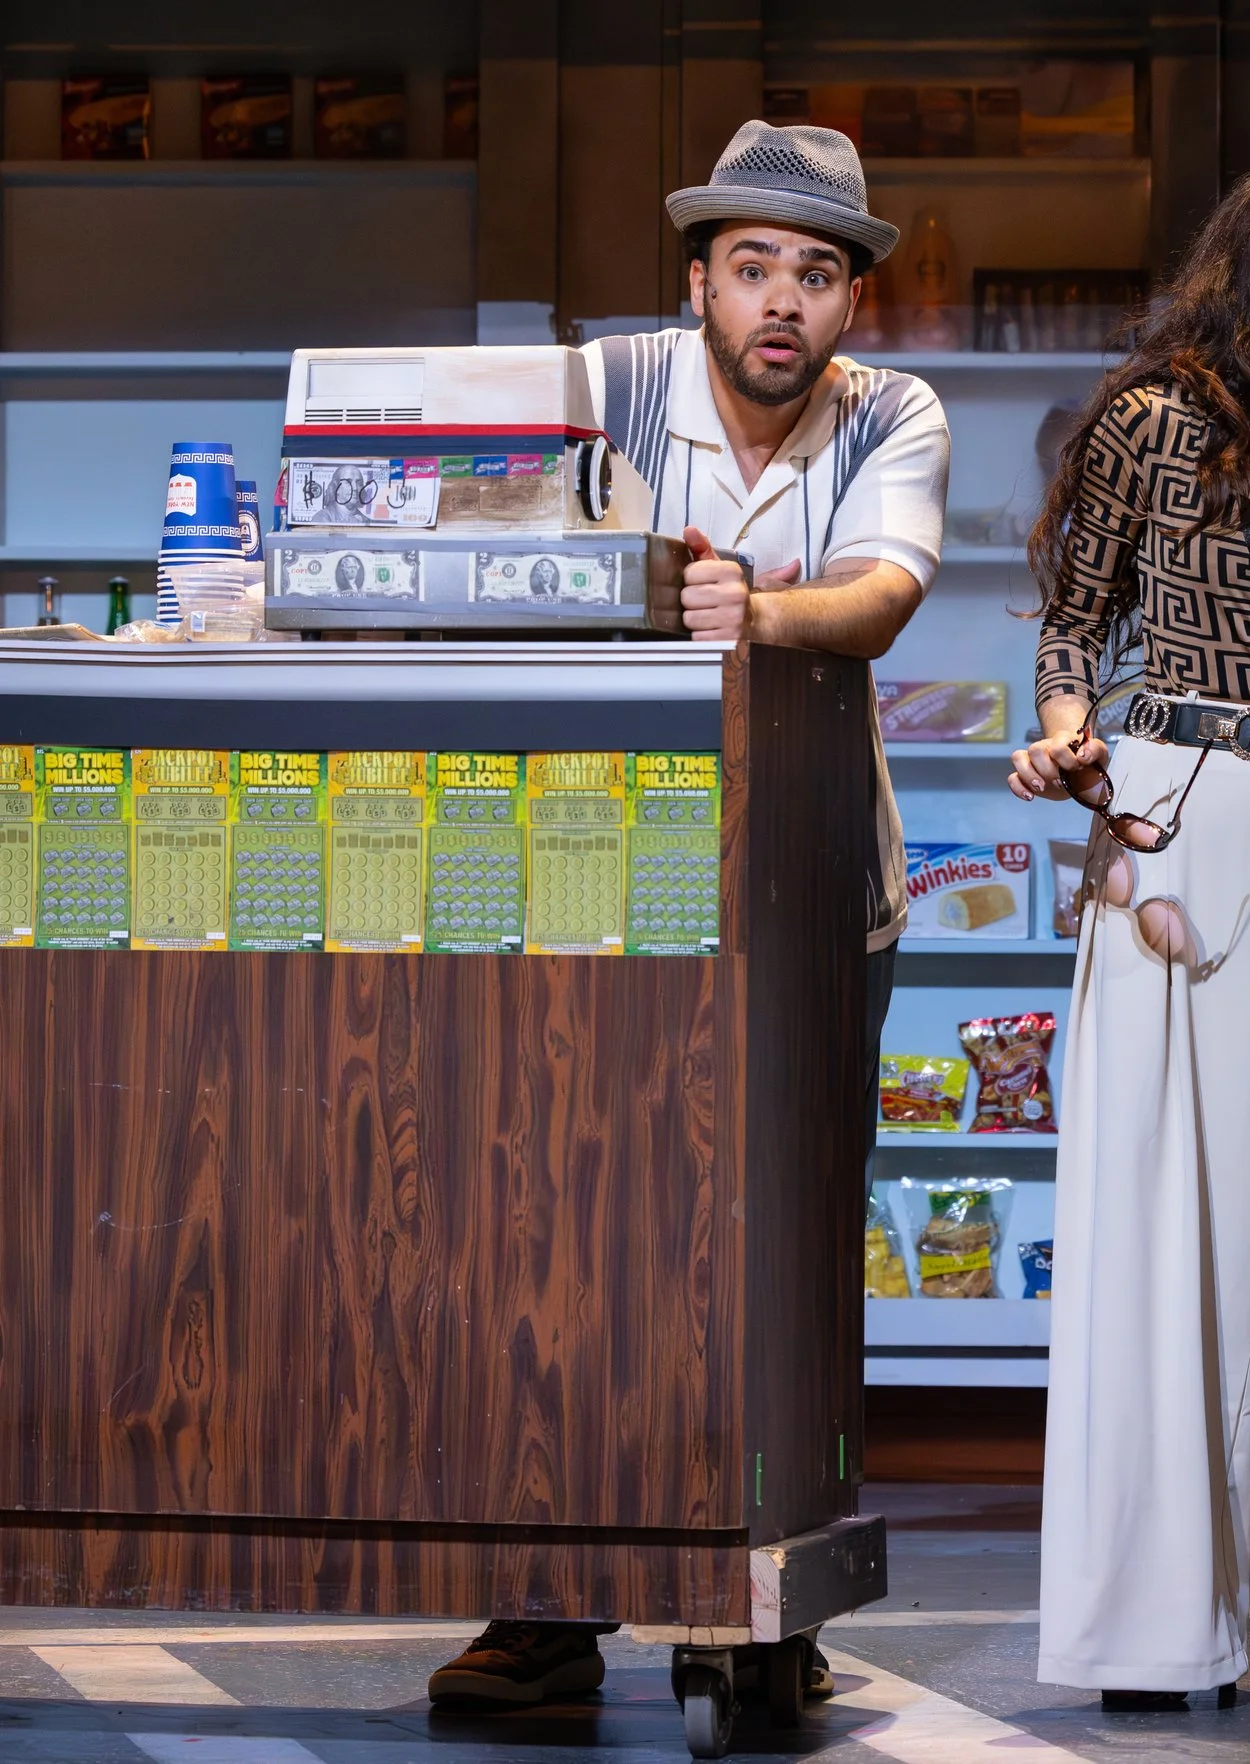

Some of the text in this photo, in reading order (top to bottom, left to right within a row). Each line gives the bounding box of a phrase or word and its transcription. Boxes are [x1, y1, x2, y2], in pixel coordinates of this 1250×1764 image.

[284, 550, 292, 560] 2
[479, 552, 488, 562] 2
[604, 554, 613, 565] 2
[45, 752, 124, 768] BIG TIME
[150, 750, 214, 766] JACKPOT
[240, 753, 320, 770] BIG TIME
[345, 752, 413, 767] JACKPOT
[438, 754, 518, 771] BIG TIME
[545, 753, 610, 770] JACKPOT
[636, 756, 717, 772] BIG TIME
[45, 768, 124, 784] MILLIONS
[240, 769, 320, 786] MILLIONS
[438, 771, 518, 788] MILLIONS
[636, 772, 717, 788] MILLIONS
[1002, 845, 1027, 862] 10
[906, 858, 992, 899] winkies
